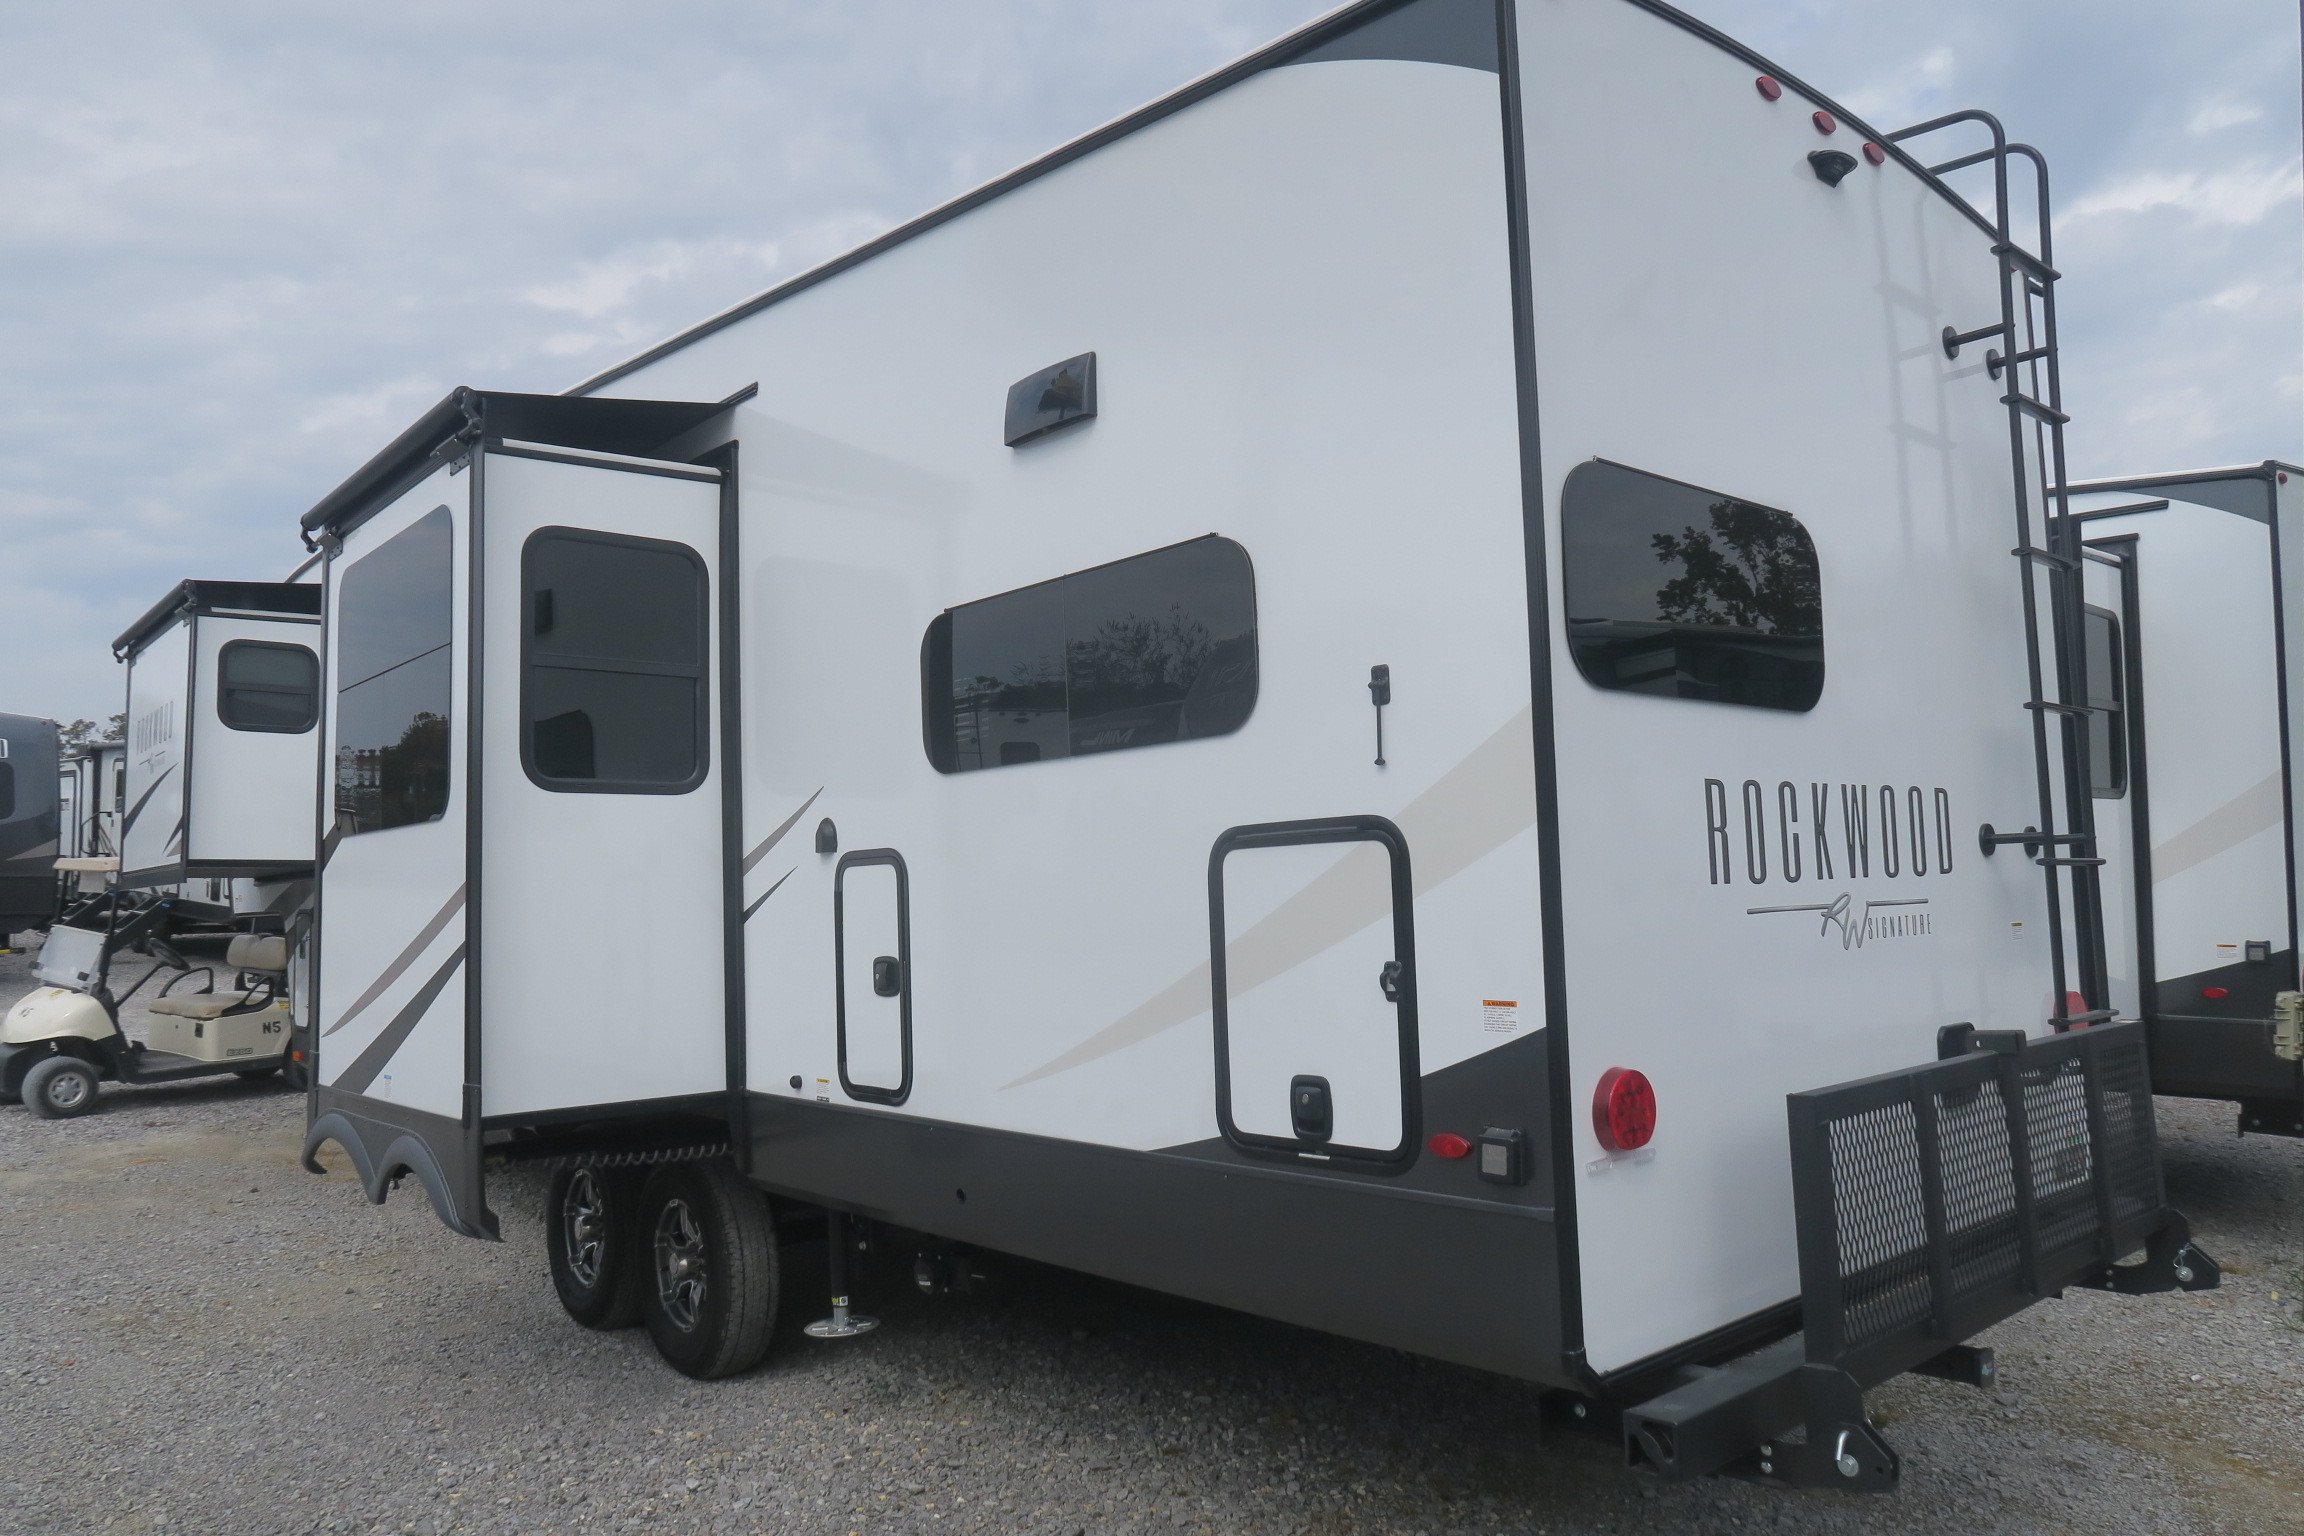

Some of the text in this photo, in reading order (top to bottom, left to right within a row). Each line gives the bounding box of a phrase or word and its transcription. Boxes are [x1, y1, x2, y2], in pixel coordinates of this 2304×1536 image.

[1704, 777, 1954, 885] ROCKWOOD
[1867, 913, 1932, 940] SIGNATURE
[262, 1020, 282, 1035] N5
